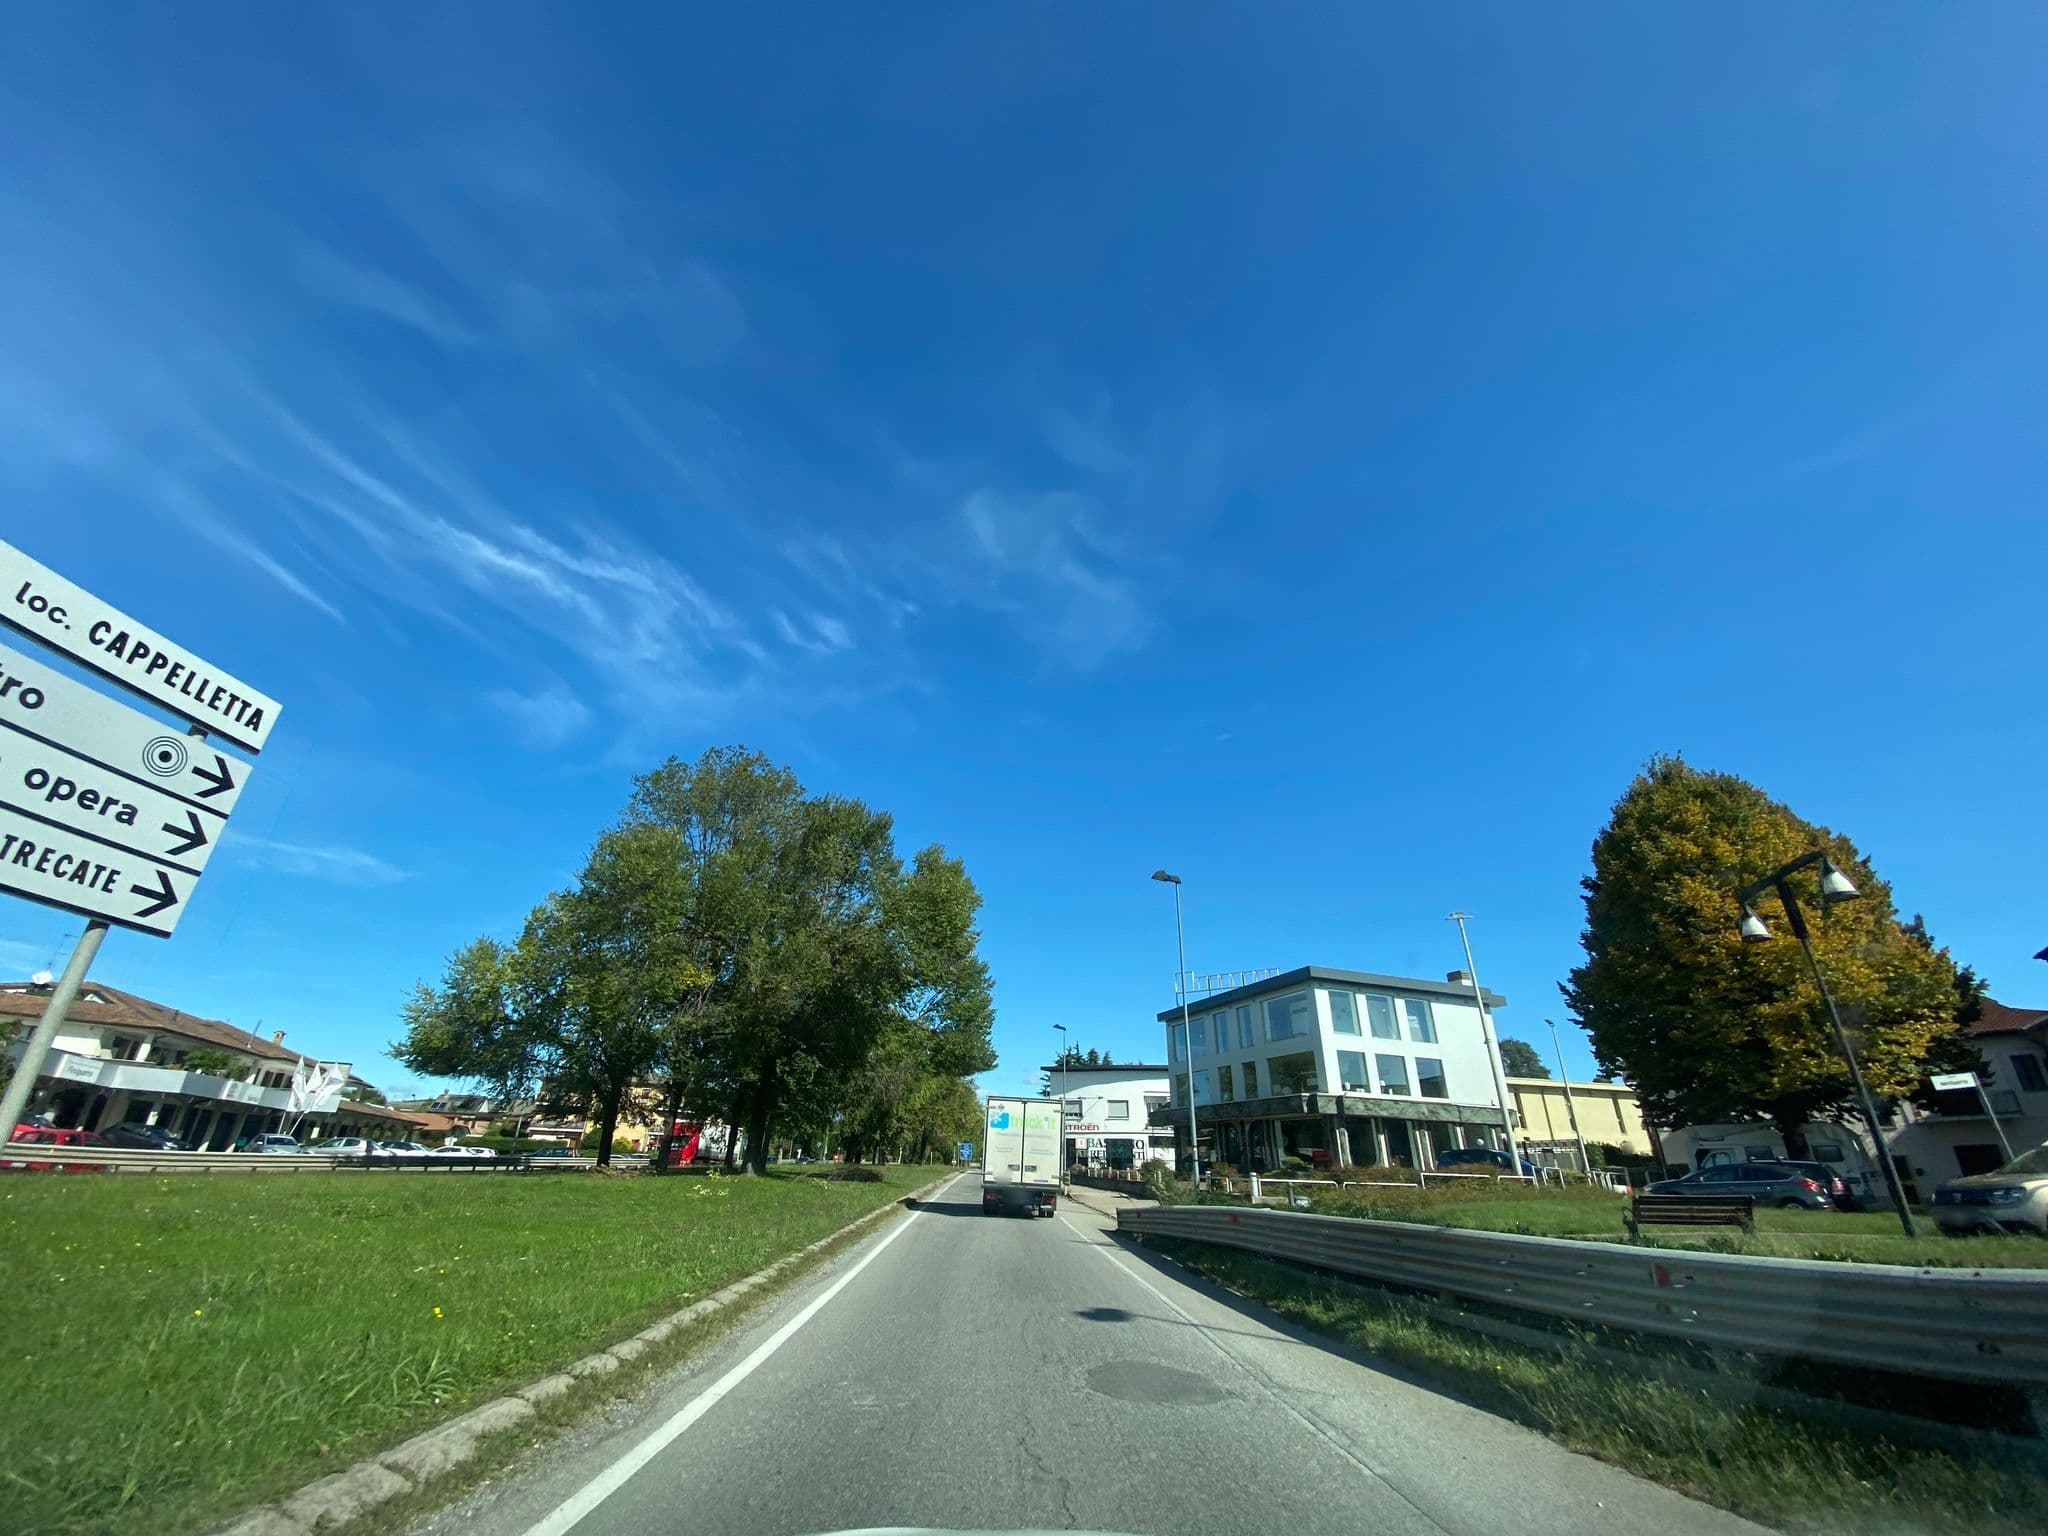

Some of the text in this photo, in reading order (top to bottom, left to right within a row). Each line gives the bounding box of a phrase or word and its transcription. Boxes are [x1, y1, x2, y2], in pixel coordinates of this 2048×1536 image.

[0, 663, 45, 710] ro
[15, 581, 266, 733] loc. CAPPELLETTA
[23, 767, 139, 826] opera
[0, 833, 122, 894] TRECATE
